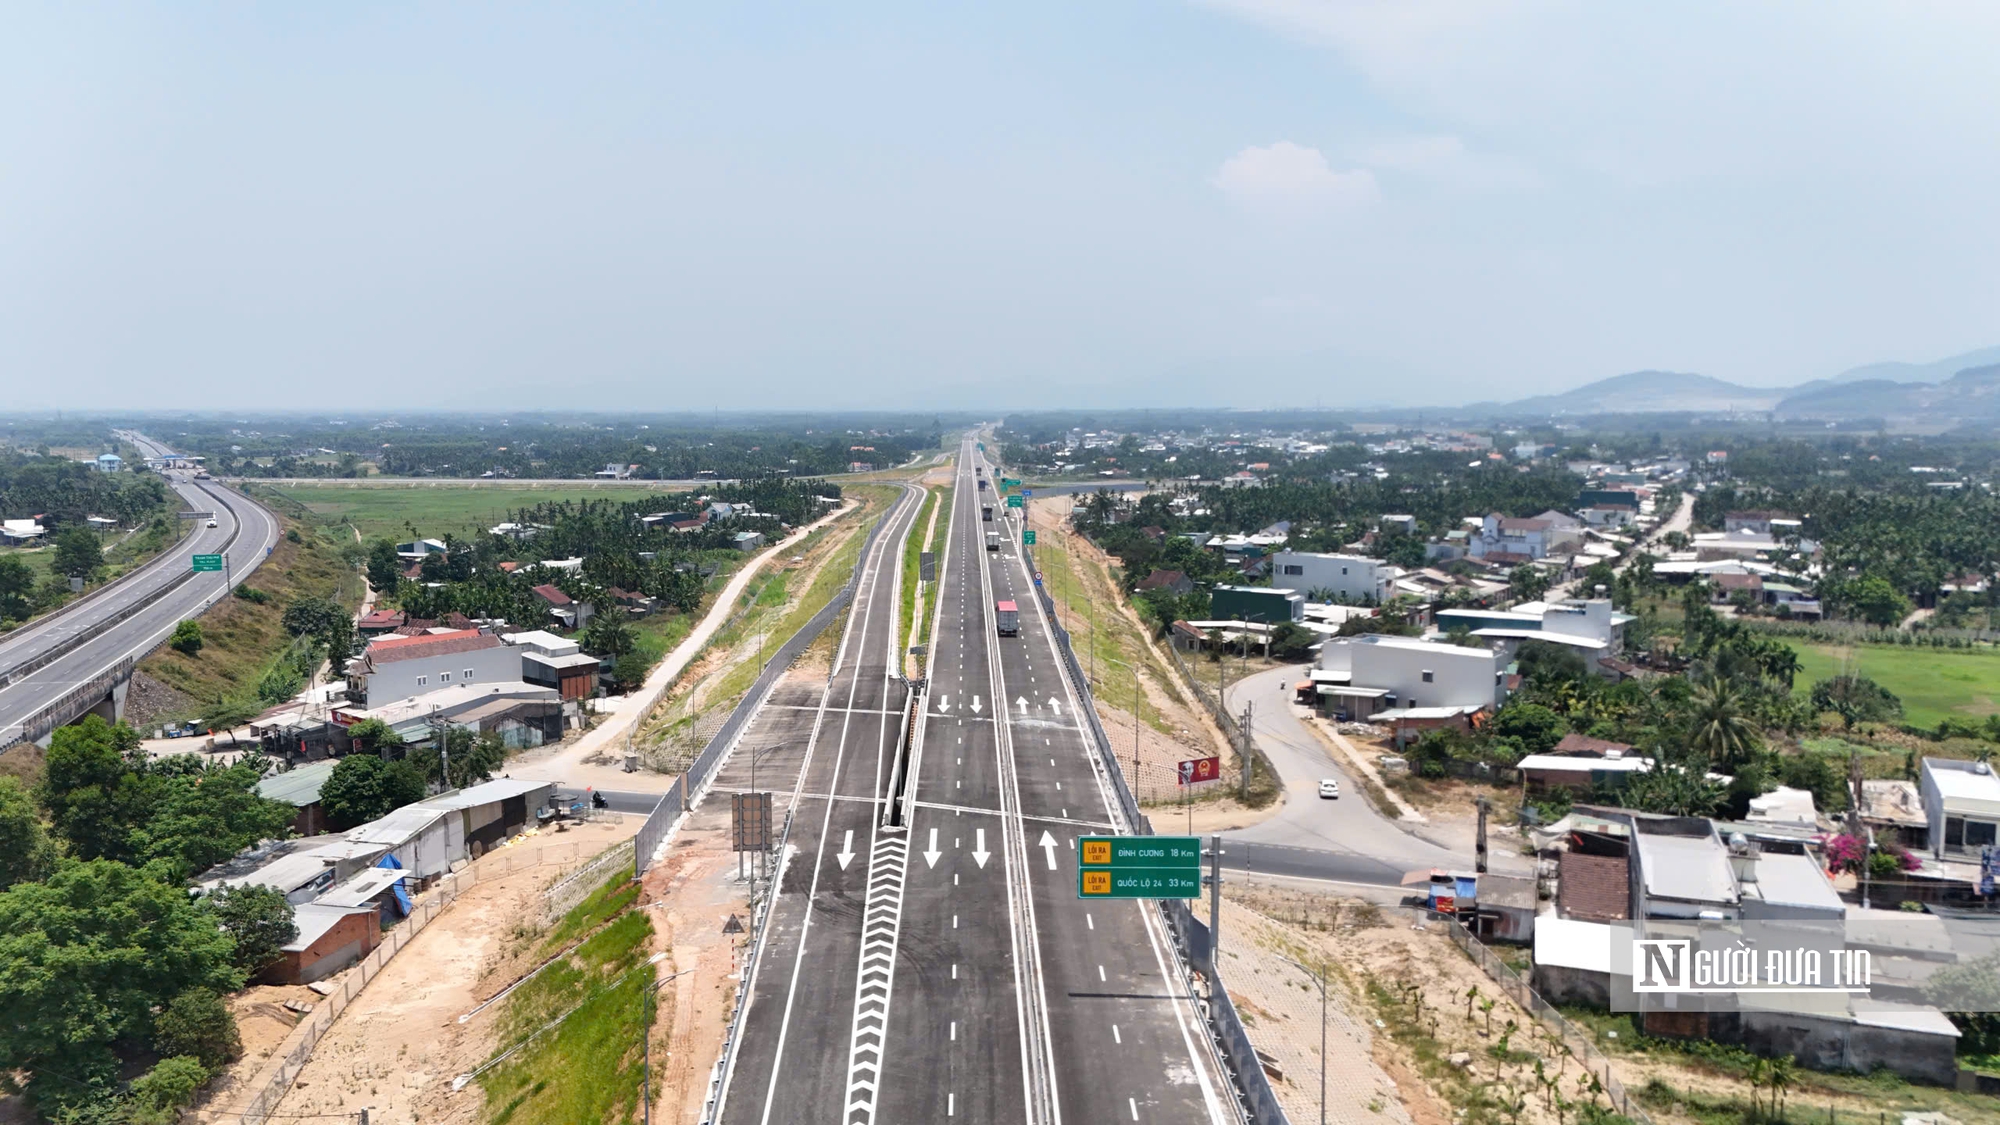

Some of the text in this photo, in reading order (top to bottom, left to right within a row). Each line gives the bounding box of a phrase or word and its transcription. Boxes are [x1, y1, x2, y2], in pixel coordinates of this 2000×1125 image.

[1118, 847, 1136, 856] ĐÌNH
[1170, 848, 1179, 857] 18
[1117, 876, 1138, 887] QUỐC
[1140, 878, 1151, 889] LỘ
[1168, 878, 1179, 887] 33
